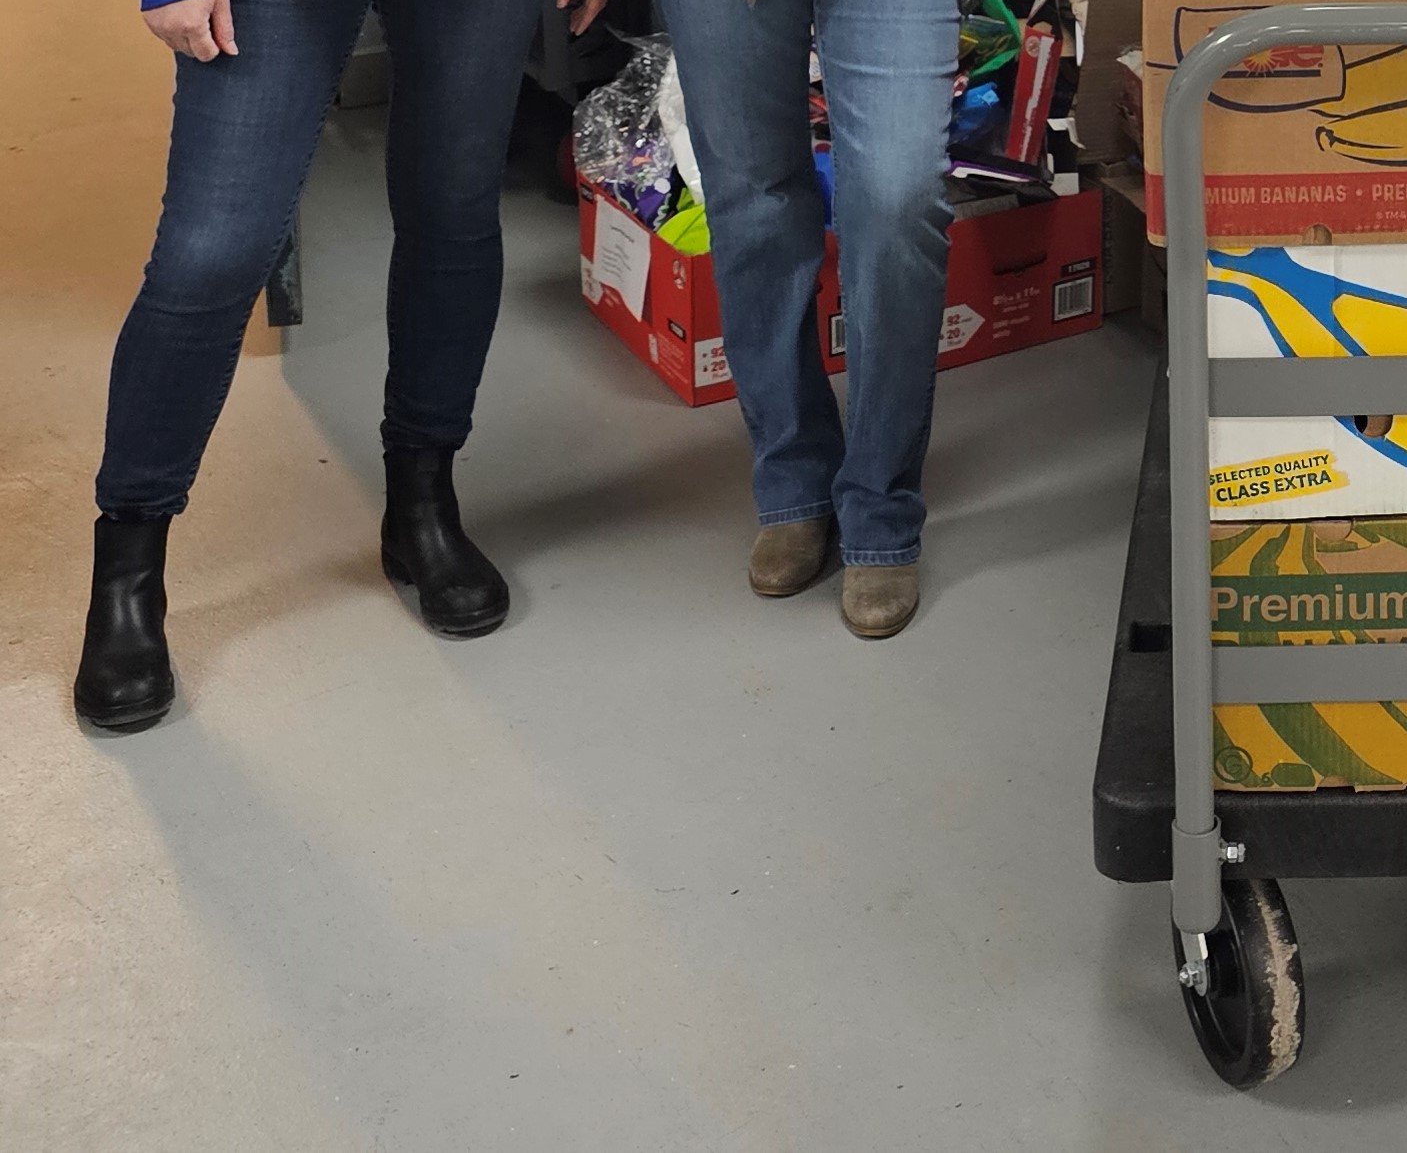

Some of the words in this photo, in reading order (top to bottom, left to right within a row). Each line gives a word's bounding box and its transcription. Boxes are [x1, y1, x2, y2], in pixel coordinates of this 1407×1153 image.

[1205, 187, 1255, 204] MIUM
[1261, 185, 1347, 204] BANANAS
[1209, 465, 1270, 487] SELECTED
[1273, 454, 1329, 475] QUALITY
[1216, 481, 1271, 502] CLASS
[1274, 470, 1332, 492] EXTRA
